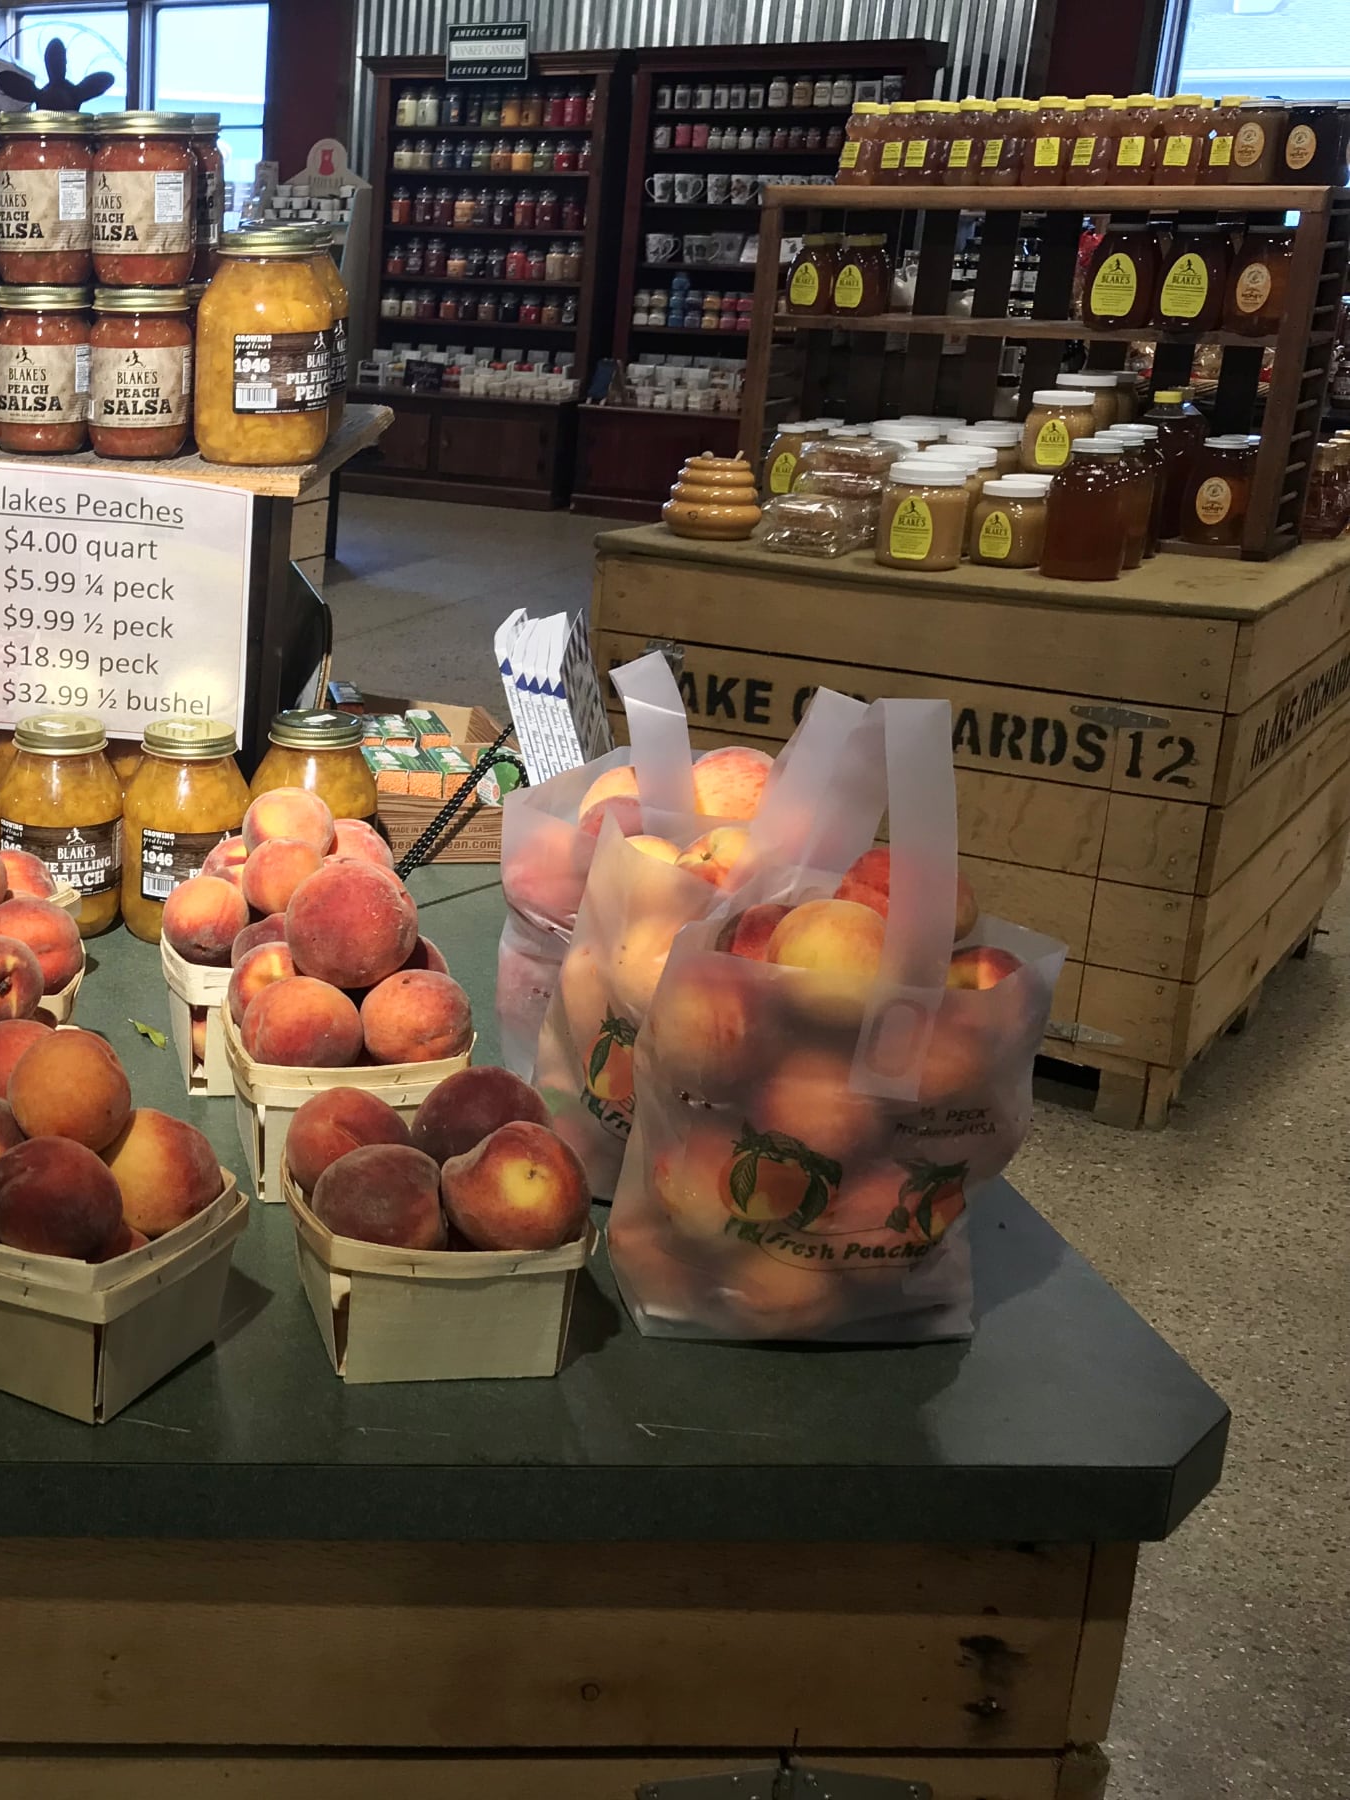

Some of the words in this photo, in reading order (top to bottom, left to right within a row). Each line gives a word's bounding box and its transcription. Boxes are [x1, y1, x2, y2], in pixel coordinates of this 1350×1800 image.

[454, 28, 499, 38] AMERICA'S
[501, 27, 522, 37] BEST
[452, 66, 488, 75] SCENTED
[490, 65, 523, 74] CANDLE
[93, 225, 140, 241] ALSA
[1101, 274, 1130, 285] BLAKE'S
[1171, 275, 1202, 286] BLAKE'S
[234, 358, 271, 373] 1946
[8, 367, 47, 381] BLAKE'S
[117, 371, 158, 385] BLAKE'S
[286, 372, 308, 385] PIE
[310, 369, 330, 383] FILL
[7, 384, 50, 395] PEACH
[115, 387, 161, 398] PEACH
[295, 382, 330, 402] PEAC
[103, 399, 172, 415] SALSA
[76, 493, 184, 524] Peaches
[4, 526, 77, 554] $4.00
[86, 539, 158, 561] quart
[3, 565, 76, 593] $5.99
[114, 577, 174, 602] peck
[3, 603, 74, 631] $9.99
[113, 616, 173, 640] peck
[3, 641, 89, 670] $18.99
[99, 653, 159, 676] peck
[2, 678, 88, 707] $32.99
[127, 689, 211, 716] bushel
[1250, 694, 1298, 772] BLAKE
[1125, 731, 1196, 786] 12
[143, 829, 176, 840] GROWING
[57, 845, 96, 860] BLAKE'S
[142, 849, 173, 866] 1946
[62, 855, 111, 873] FILLING
[946, 1107, 991, 1122] PECK
[969, 1121, 997, 1135] USA
[766, 1231, 835, 1260] Fresh
